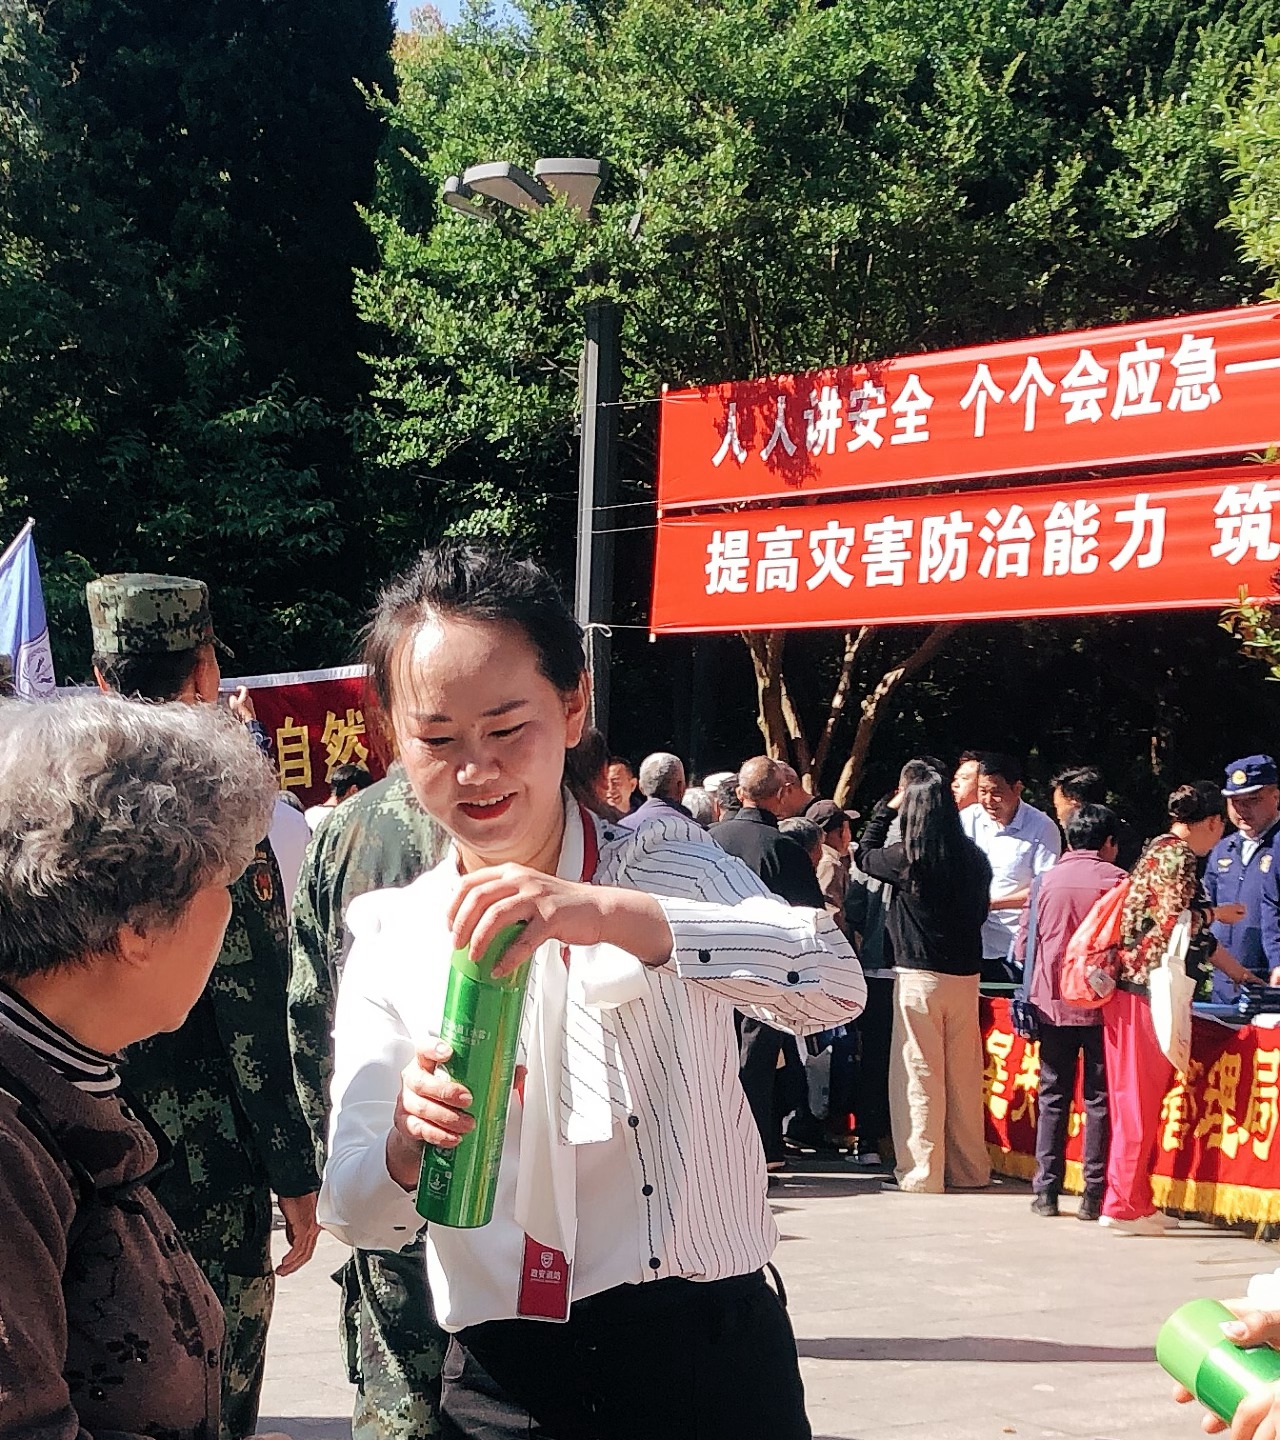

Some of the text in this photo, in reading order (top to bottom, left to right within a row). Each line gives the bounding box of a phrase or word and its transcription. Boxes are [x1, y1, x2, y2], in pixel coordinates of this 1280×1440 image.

[712, 374, 934, 467] 人人讲安全
[704, 493, 1167, 596] 提高灾害防治能力
[276, 708, 370, 791] 自然
